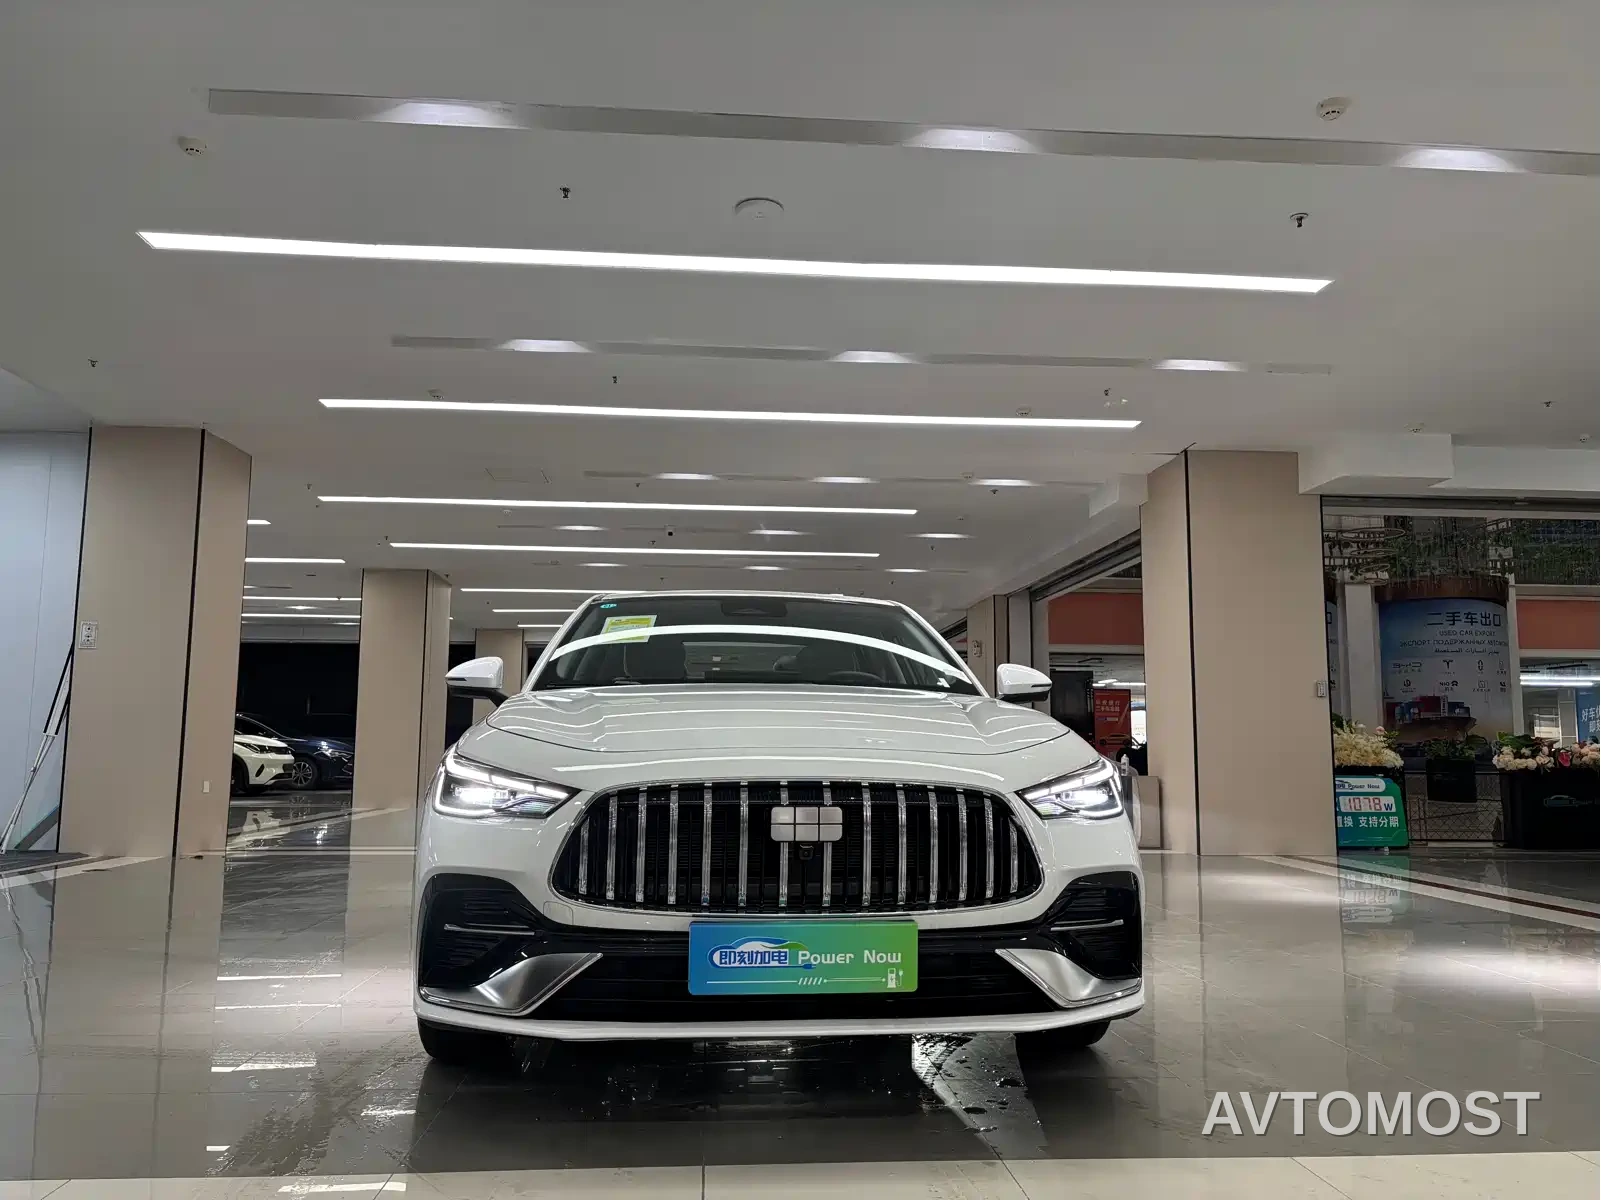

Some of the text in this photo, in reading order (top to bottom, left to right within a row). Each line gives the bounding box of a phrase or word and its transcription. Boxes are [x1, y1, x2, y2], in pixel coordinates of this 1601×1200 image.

[1426, 611, 1502, 627] 二手车出口
[1439, 629, 1458, 637] USED
[1459, 629, 1473, 637] CAR
[1358, 815, 1399, 828] 支持分期
[719, 949, 902, 965] 即刻加电 Power Now
